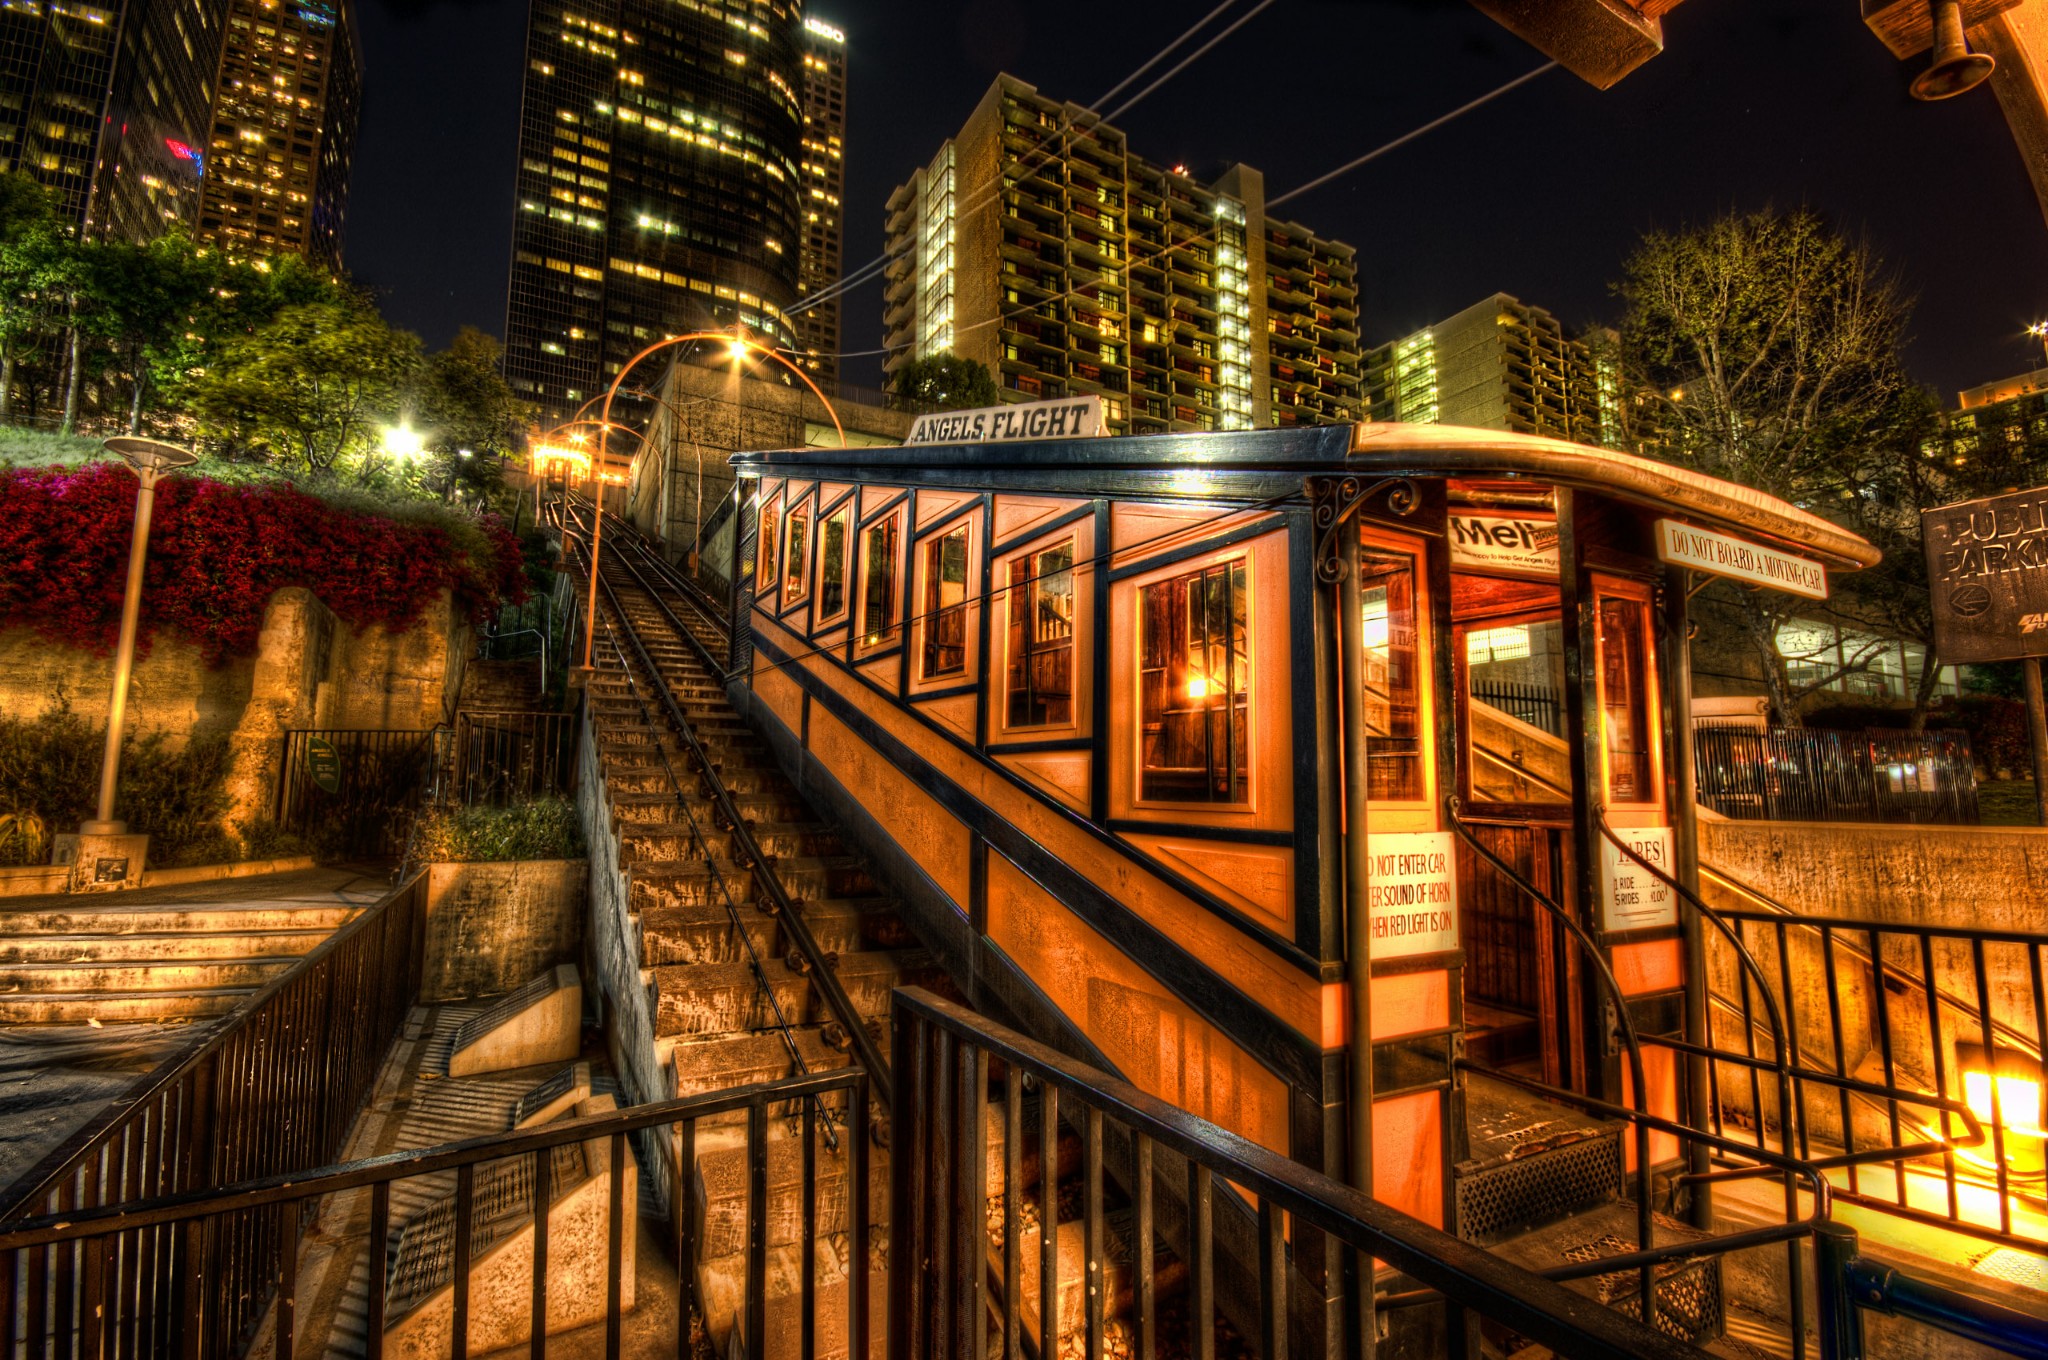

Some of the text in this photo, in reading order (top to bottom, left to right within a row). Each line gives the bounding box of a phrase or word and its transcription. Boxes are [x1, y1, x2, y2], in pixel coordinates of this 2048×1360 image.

[914, 403, 1089, 442] ANGELS FLIGHT
[1672, 529, 1822, 591] DO NOT BOARD A MOVING CAR
[1377, 854, 1395, 877] NOT
[1399, 853, 1427, 875] ENTER
[1428, 852, 1446, 873] CAR
[1384, 883, 1414, 906] SOUND
[1416, 882, 1427, 904] OF
[1428, 881, 1451, 903] HORN
[1615, 894, 1620, 905] 5
[1621, 892, 1639, 904] RIDES
[1390, 914, 1406, 937] RED
[1408, 912, 1429, 934] LIGHT
[1430, 911, 1438, 932] IS
[1440, 910, 1452, 931] ON
